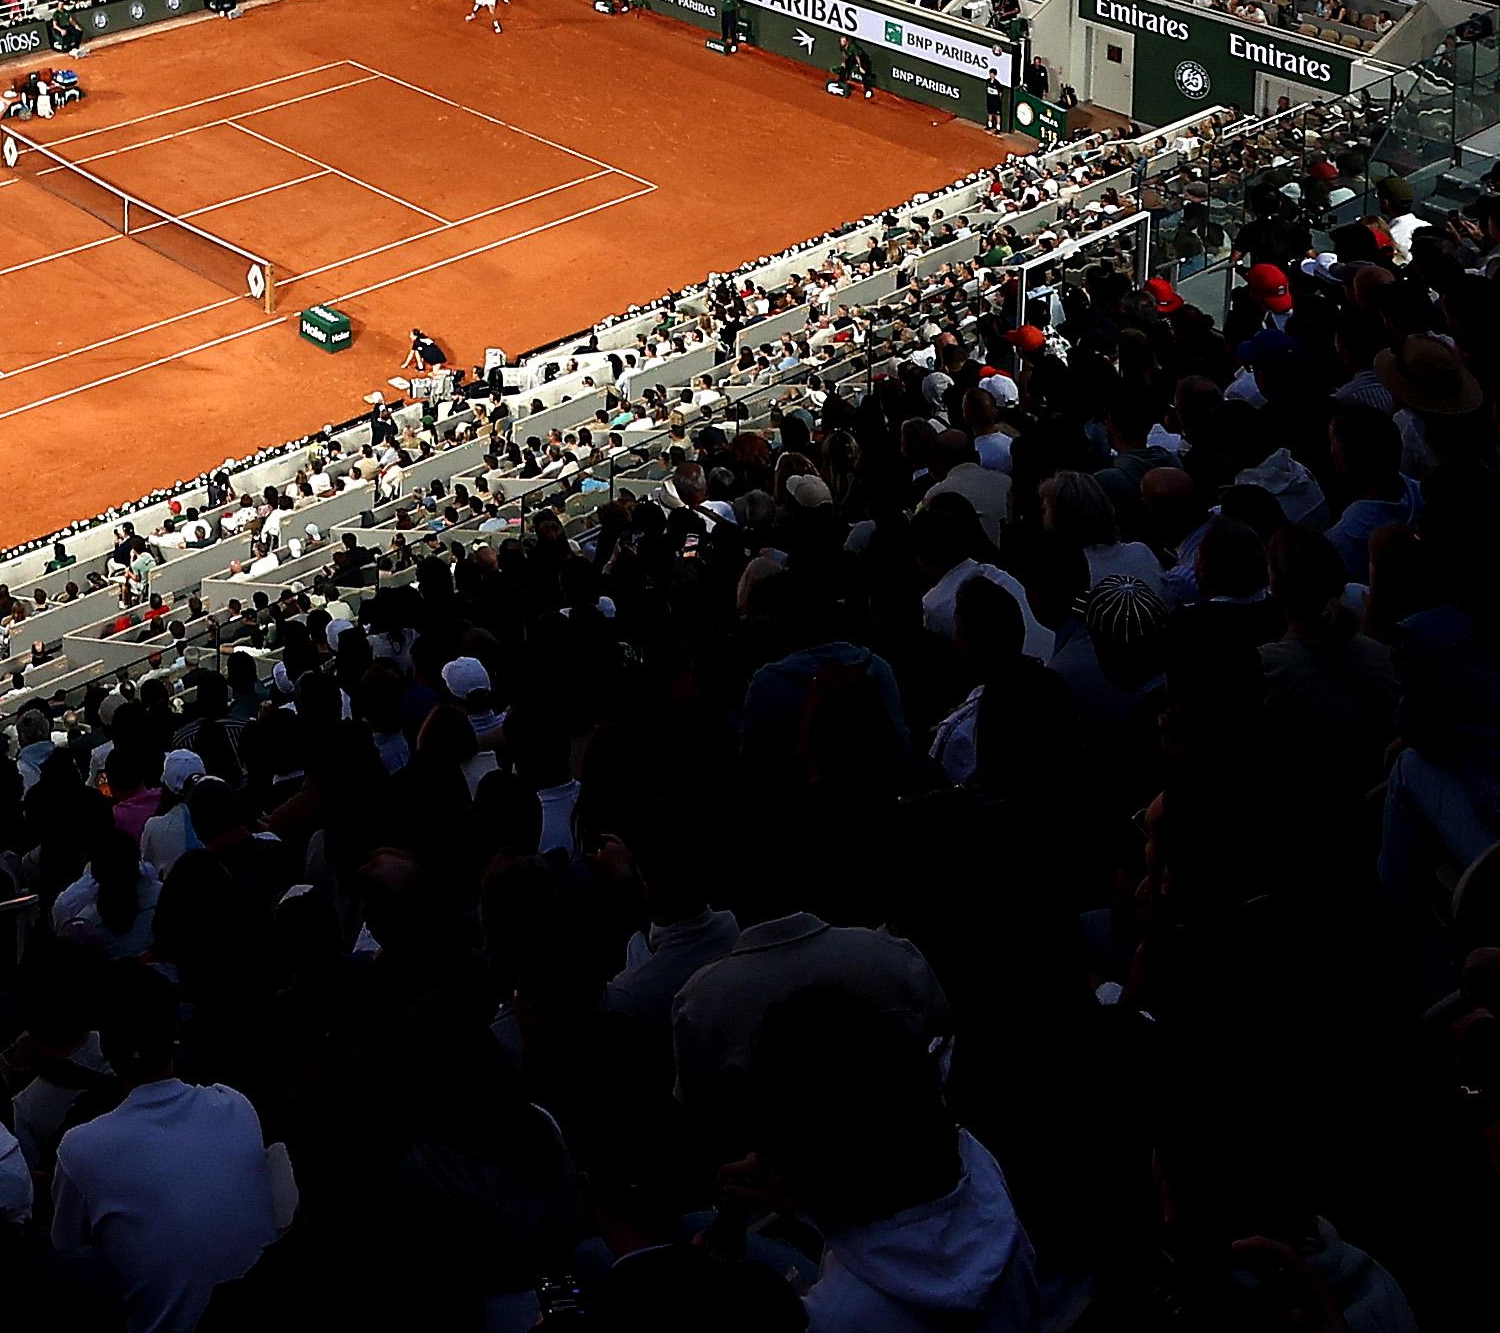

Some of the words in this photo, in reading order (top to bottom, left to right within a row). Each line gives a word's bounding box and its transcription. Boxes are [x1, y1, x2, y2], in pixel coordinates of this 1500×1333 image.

[906, 32, 933, 51] BNP
[935, 40, 989, 70] PARIBAS
[1229, 33, 1331, 83] Emirates
[892, 66, 914, 84] BNP
[916, 76, 961, 99] PARIBAS
